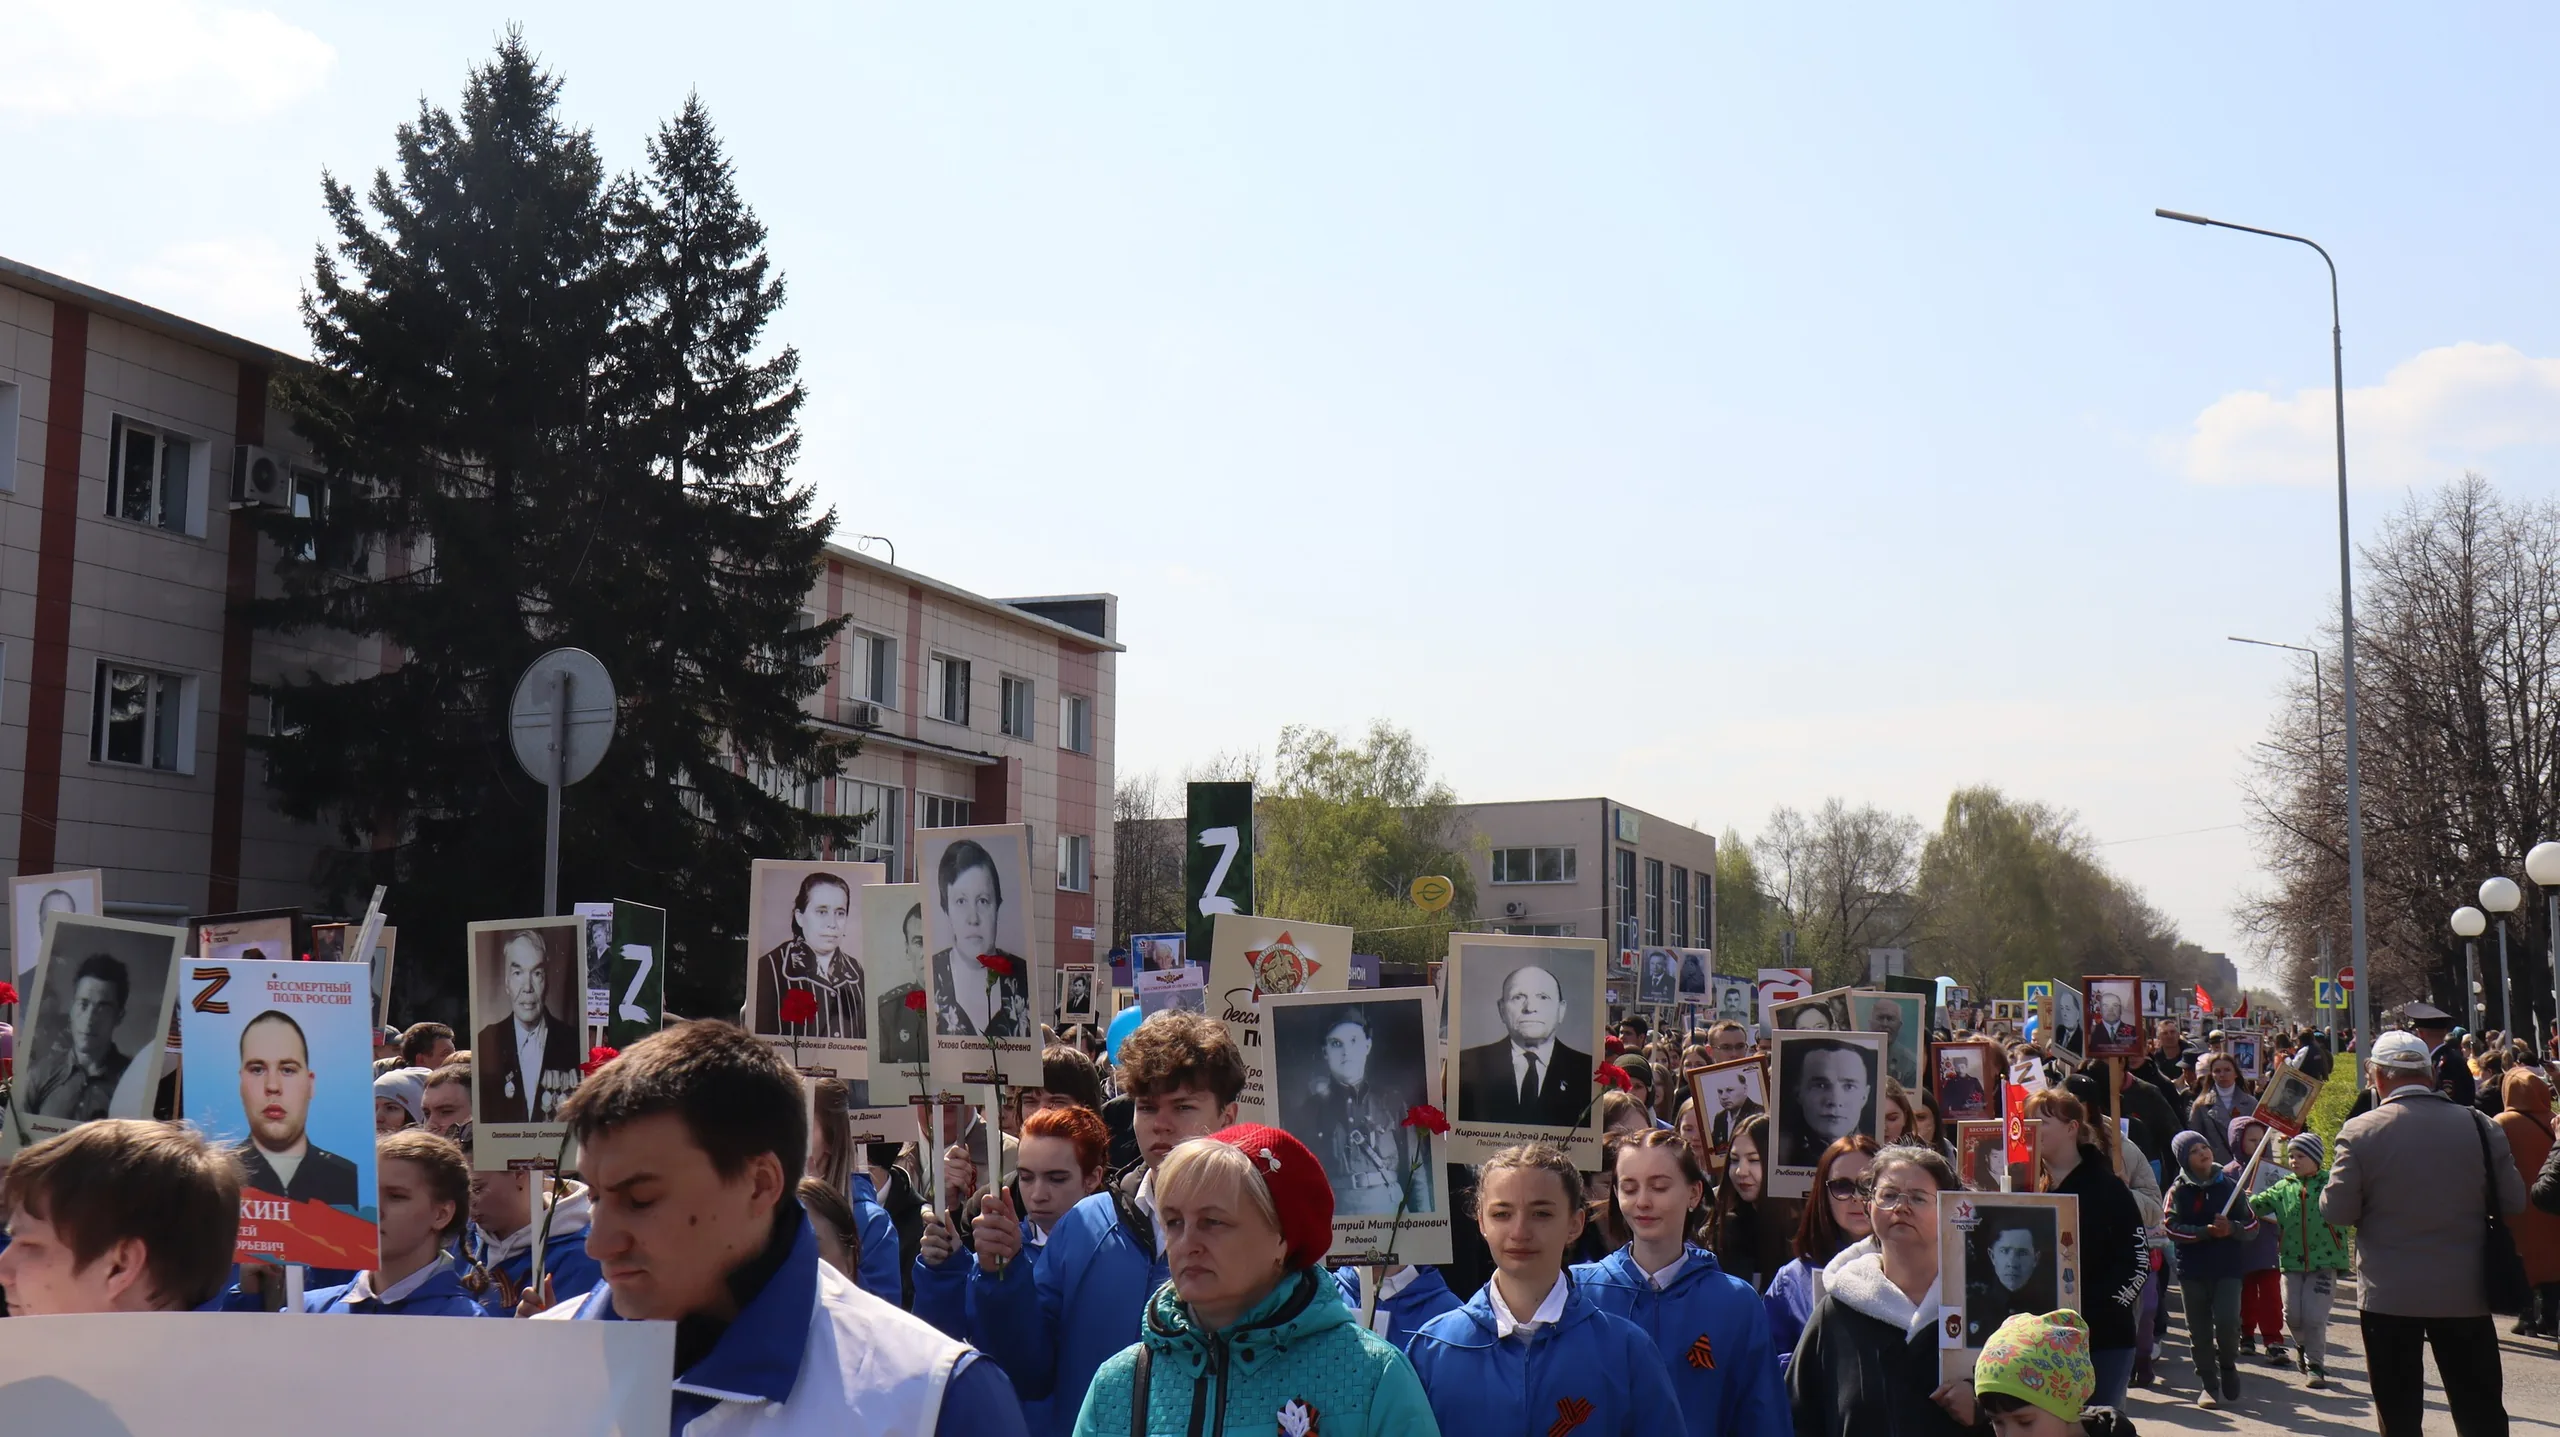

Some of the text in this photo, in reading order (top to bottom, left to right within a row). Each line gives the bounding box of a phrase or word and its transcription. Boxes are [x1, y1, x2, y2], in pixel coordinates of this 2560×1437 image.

[1196, 826, 1243, 917] Z
[266, 980, 352, 993] БЕССМЕРТНЫЙ
[619, 943, 653, 1024] Z
[191, 967, 231, 1014] Z
[273, 993, 352, 1005] ПОЛК РОССИИ
[937, 1040, 959, 1050] Ускова
[994, 1041, 1032, 1053] Андреевна
[859, 1113, 882, 1121] Данил
[522, 1130, 538, 1139] Захар
[1454, 1127, 1501, 1139] Кирюшин
[1503, 1130, 1539, 1142] Андрей
[1775, 1168, 1805, 1177] Рыбаков
[1368, 1217, 1448, 1232] Митрафанович
[1344, 1235, 1378, 1244] Рядовой
